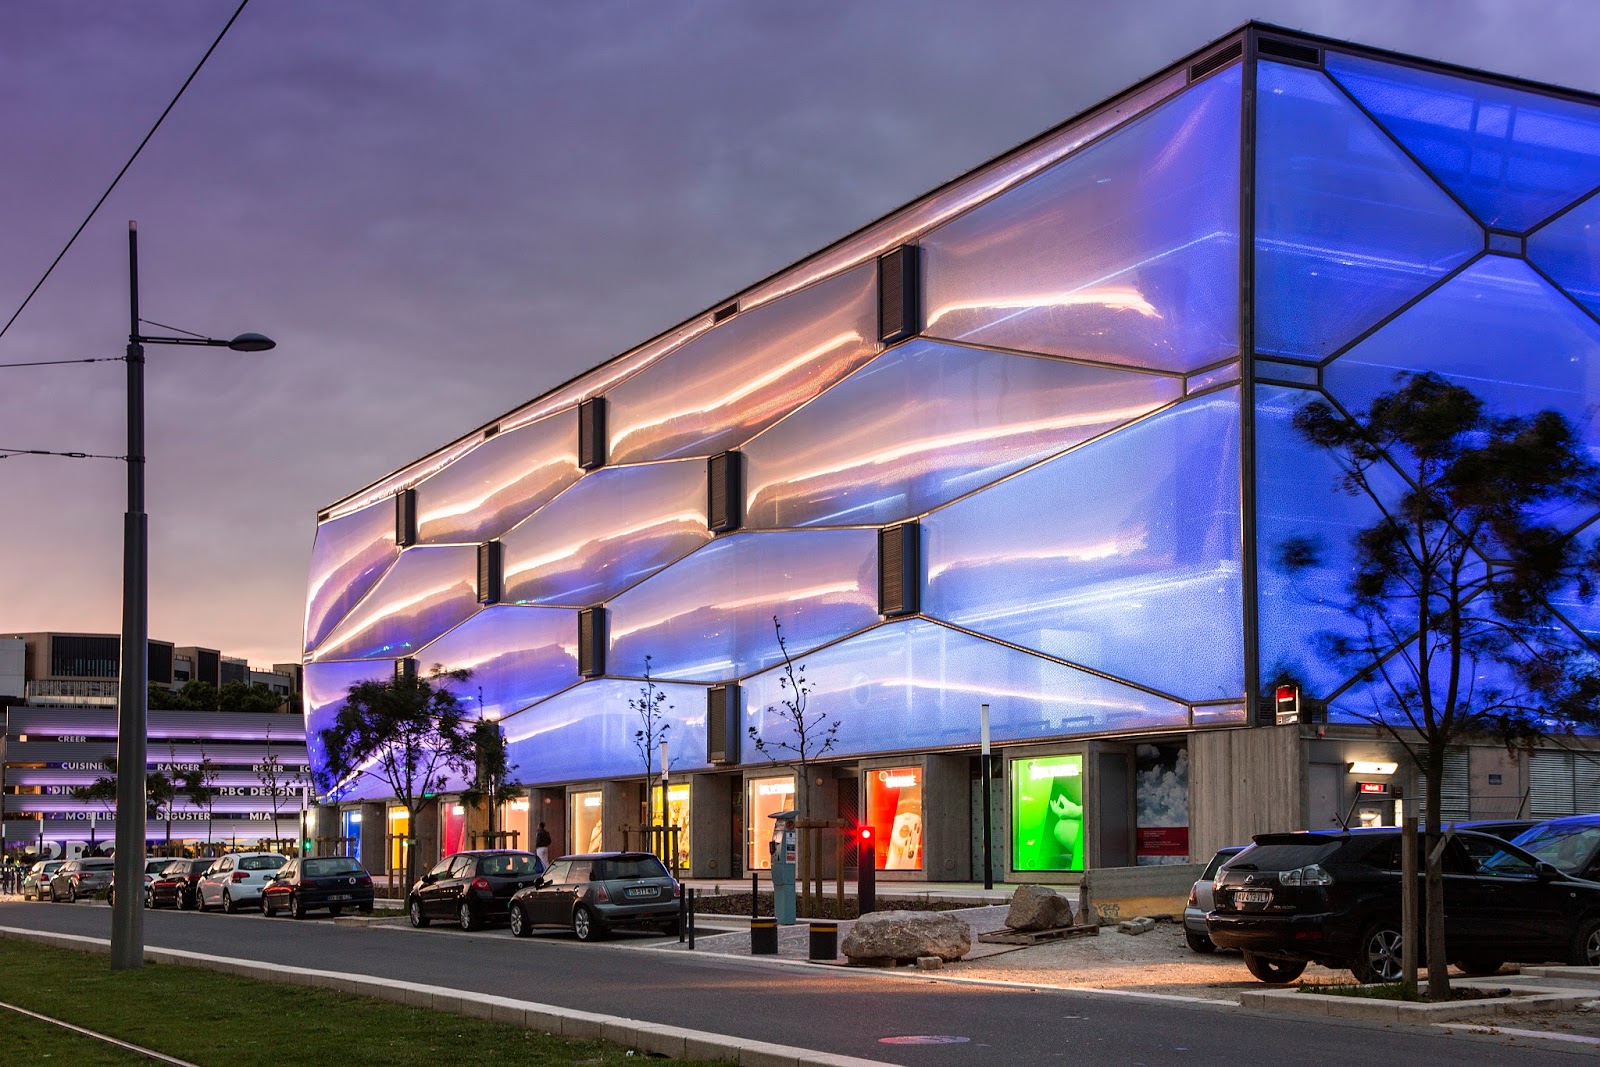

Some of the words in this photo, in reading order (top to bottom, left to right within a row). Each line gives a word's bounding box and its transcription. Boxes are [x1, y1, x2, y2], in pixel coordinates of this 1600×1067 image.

[157, 763, 200, 771] RANGER
[250, 787, 296, 796] DESGN
[249, 812, 271, 821] MIA
